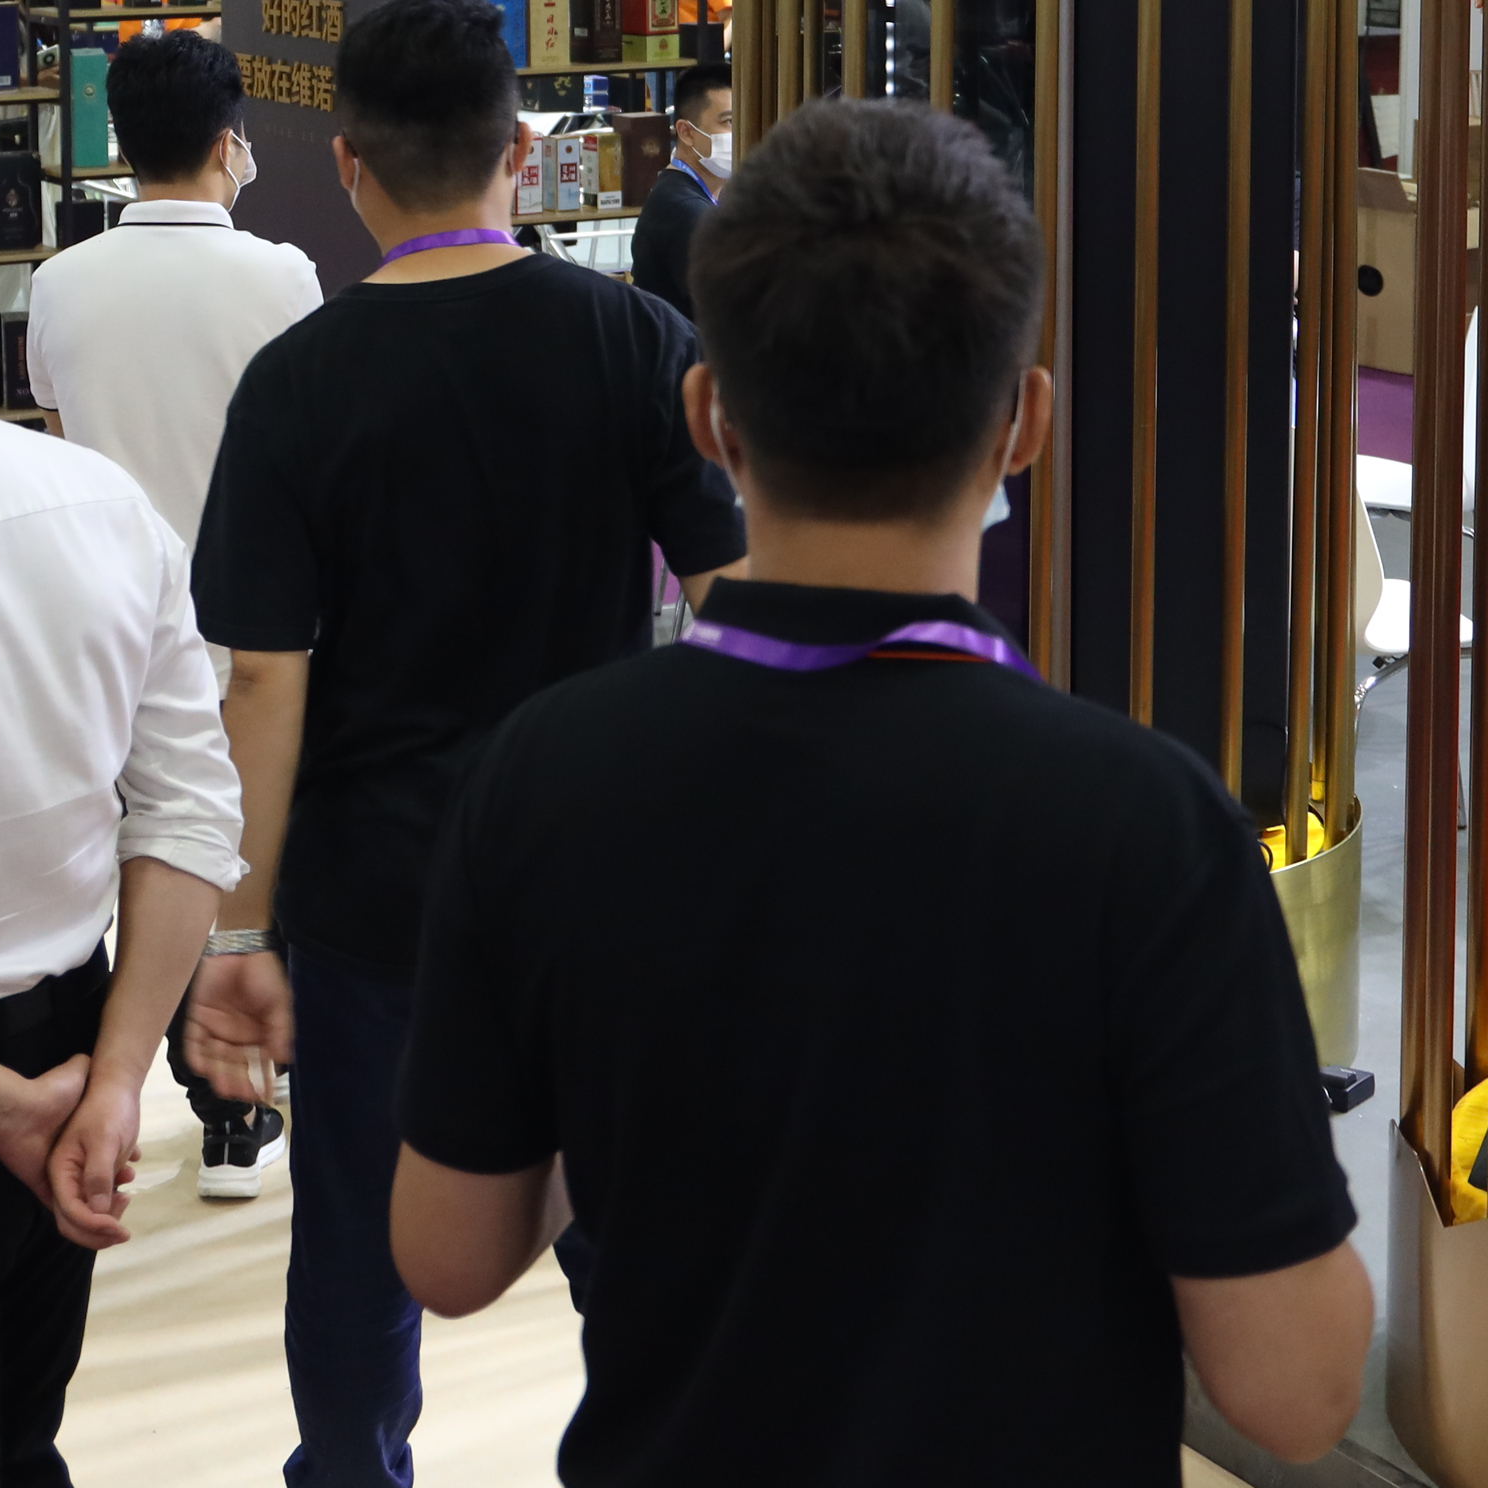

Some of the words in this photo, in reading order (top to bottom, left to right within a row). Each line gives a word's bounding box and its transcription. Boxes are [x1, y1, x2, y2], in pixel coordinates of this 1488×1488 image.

[236, 53, 336, 112] 要放在维诺
